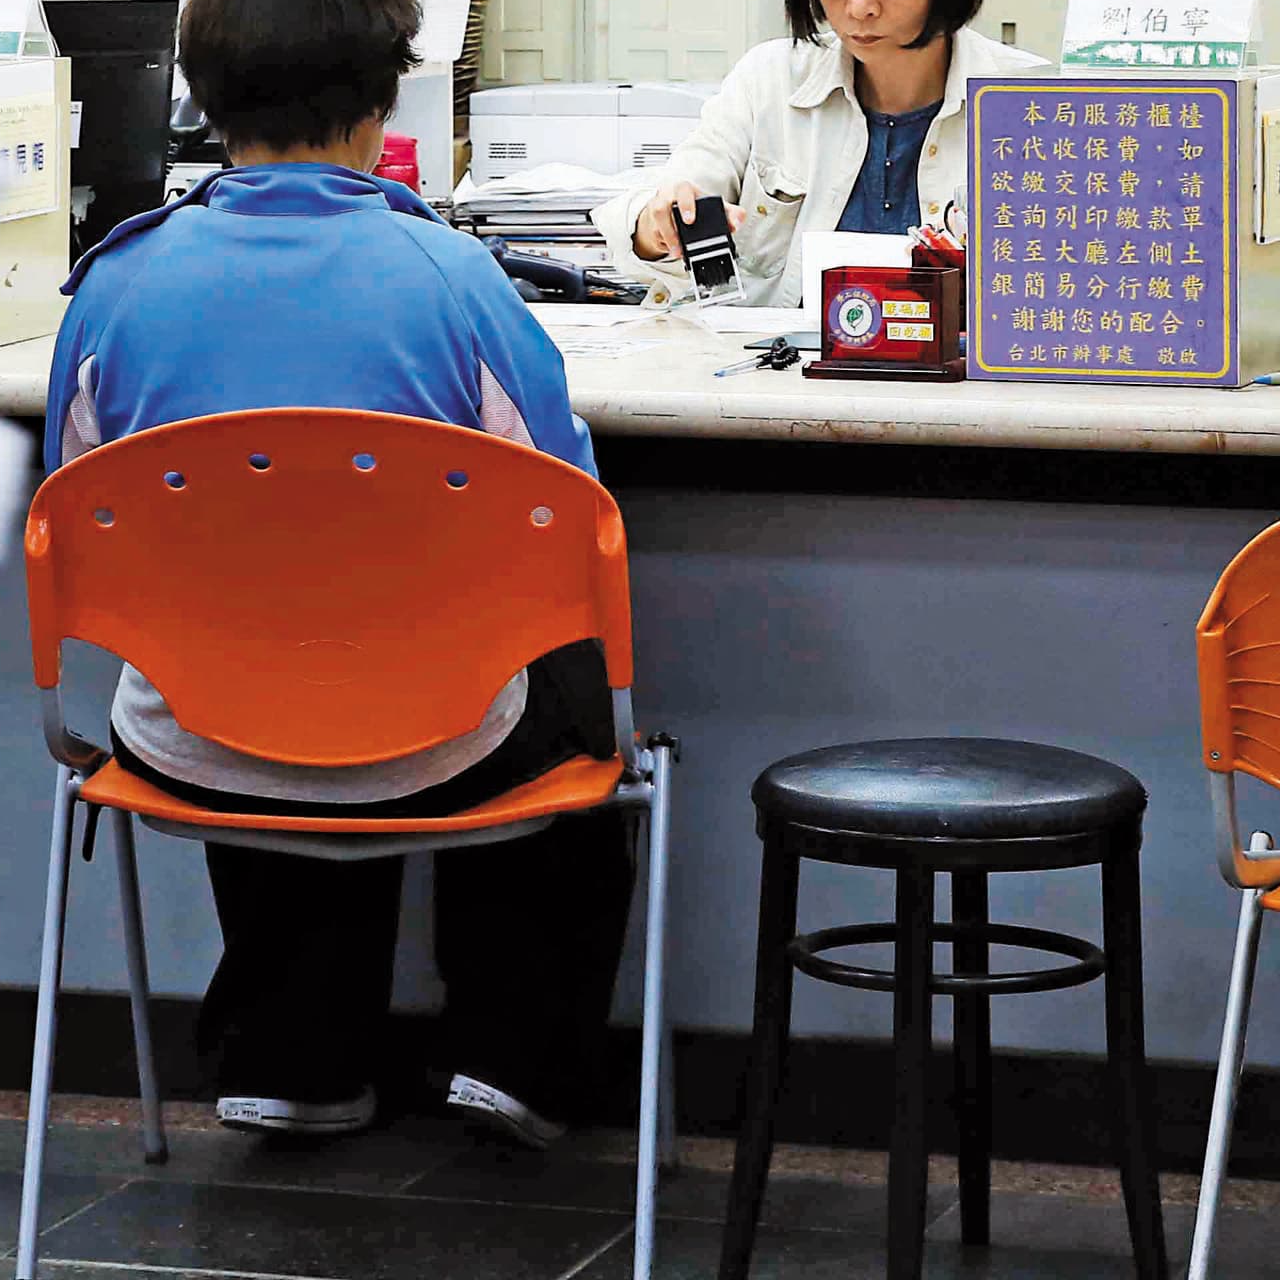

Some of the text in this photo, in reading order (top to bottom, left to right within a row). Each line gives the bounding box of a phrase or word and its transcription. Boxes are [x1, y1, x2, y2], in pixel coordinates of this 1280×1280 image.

[1023, 100, 1205, 129] 本局服務櫃檯
[993, 202, 1205, 232] 查詢列印繳款單
[991, 238, 1205, 266] 後至大廳左側土
[991, 272, 1205, 302] 銀簡易分行繳費
[1009, 343, 1136, 365] 台北市辦事處
